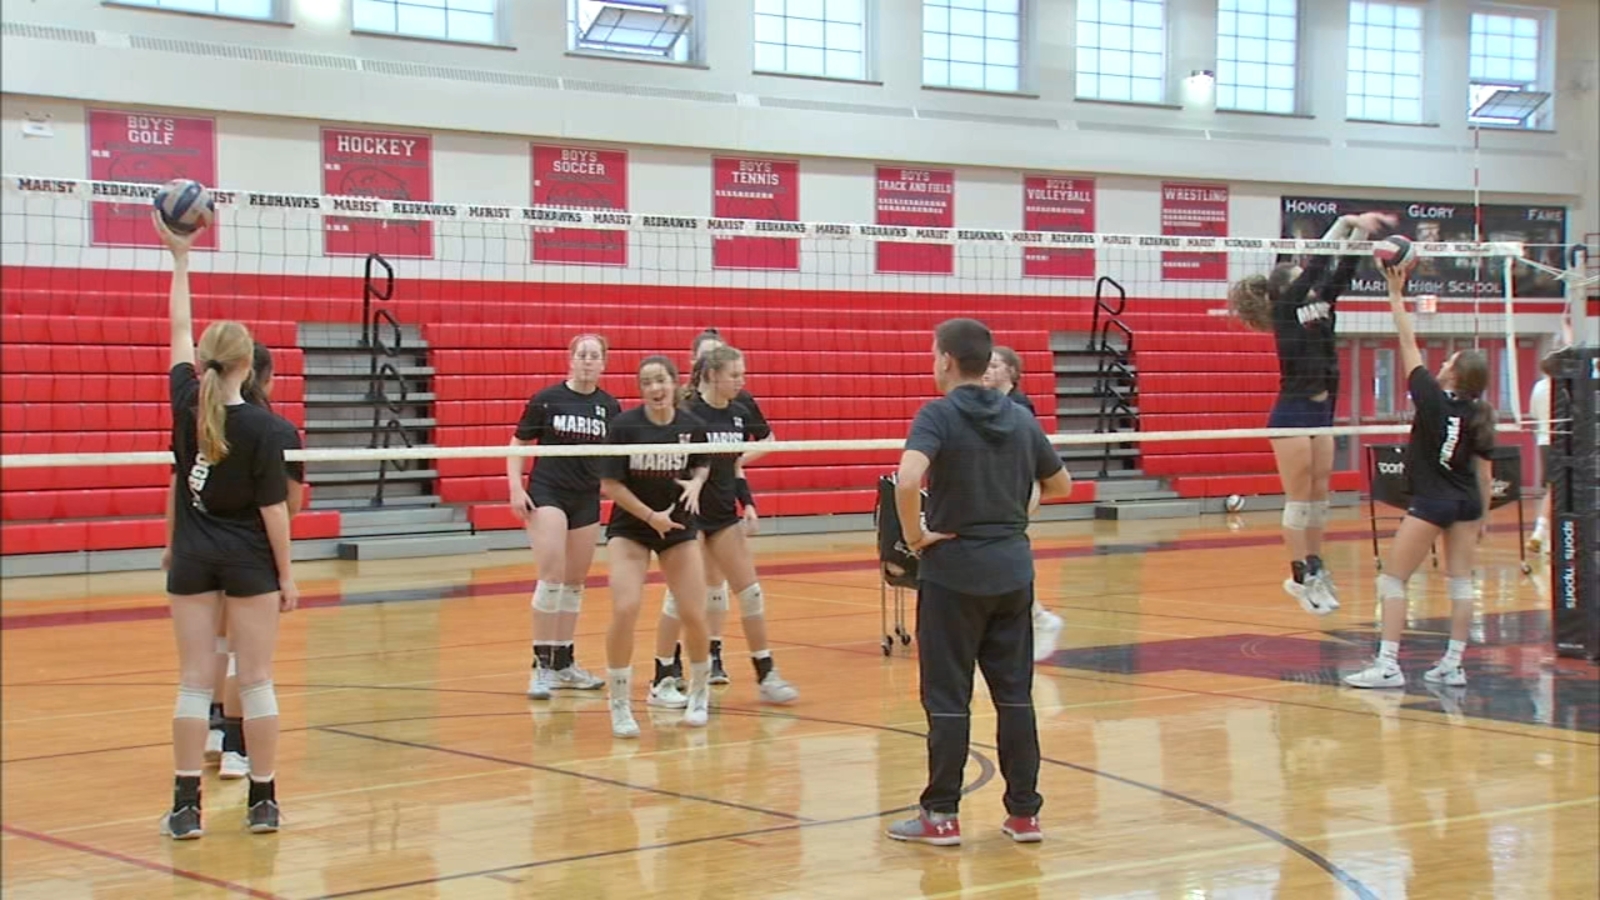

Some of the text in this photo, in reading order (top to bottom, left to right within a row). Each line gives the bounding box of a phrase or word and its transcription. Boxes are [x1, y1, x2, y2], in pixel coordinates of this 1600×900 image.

[127, 116, 175, 131] BOYS
[127, 129, 175, 145] GOLF
[336, 134, 416, 156] HOCKEY
[561, 149, 598, 162] BOYS
[552, 160, 606, 175] SOCCER
[739, 160, 773, 172] BOYS
[731, 171, 780, 185] TENNIS
[900, 169, 930, 182] BOYS
[879, 179, 951, 194] TRACK AND FIELD
[19, 177, 76, 194] MARIST
[249, 193, 321, 209] REDHAWKS
[333, 199, 380, 213] MARIST
[392, 202, 457, 217] REDHAWKS
[469, 206, 511, 219] MARIST
[522, 208, 582, 223] REDHAWKS
[593, 213, 632, 226] MARIST
[1027, 188, 1092, 202] VOLLEYBALL
[1163, 187, 1228, 202] WRESTLING
[1284, 200, 1338, 216] HONOR
[1408, 204, 1455, 220] GLORY
[1527, 208, 1563, 222] FAME
[1408, 280, 1445, 294] HIGH
[1448, 281, 1502, 294] SCHOOL
[1562, 520, 1576, 560] sports
